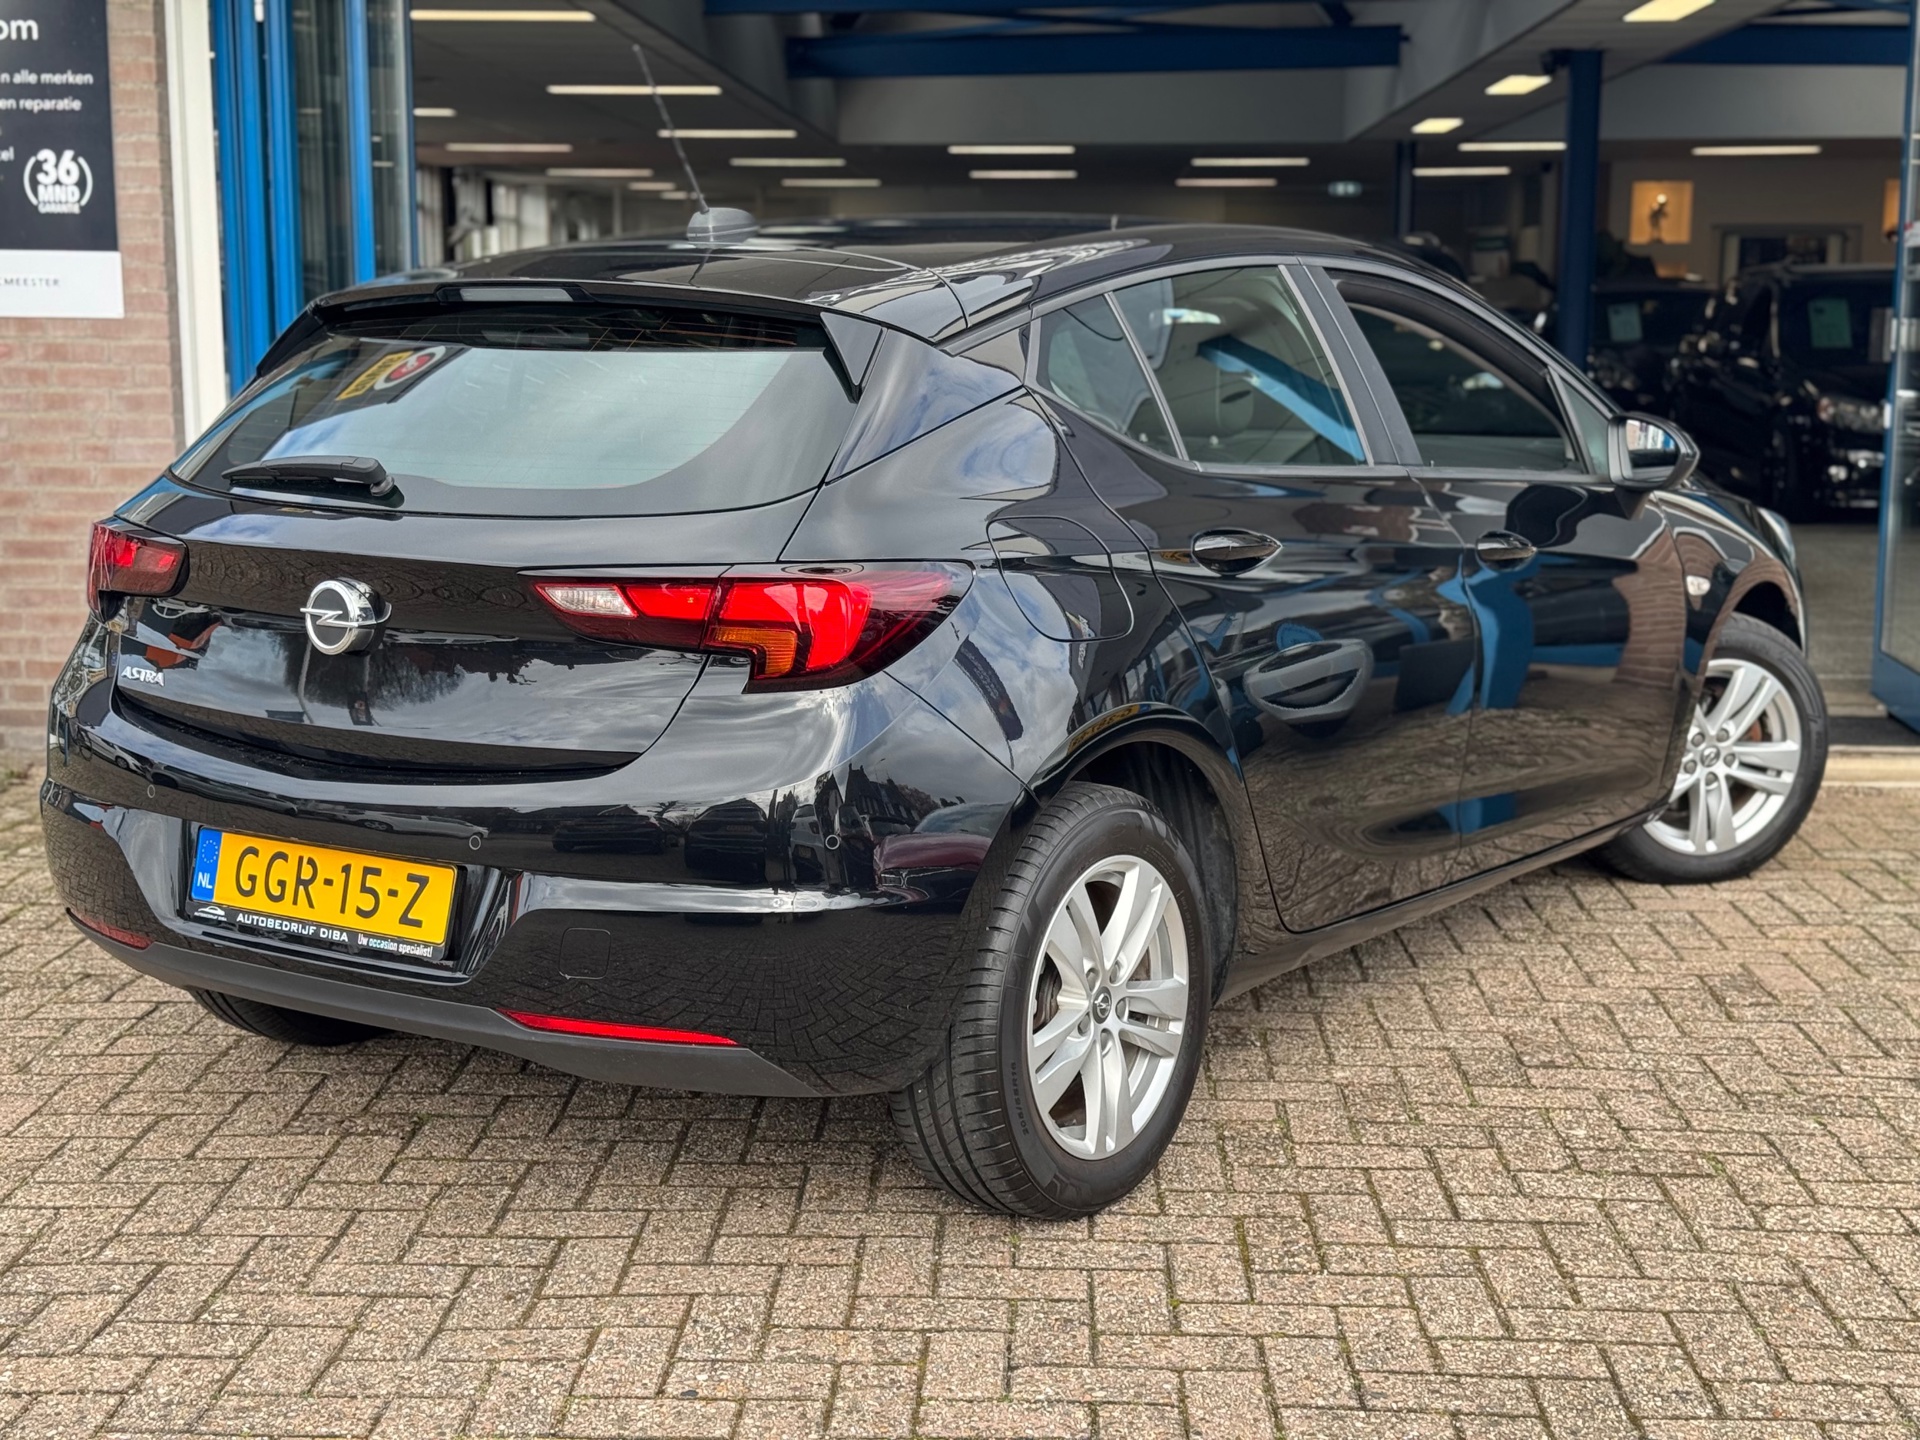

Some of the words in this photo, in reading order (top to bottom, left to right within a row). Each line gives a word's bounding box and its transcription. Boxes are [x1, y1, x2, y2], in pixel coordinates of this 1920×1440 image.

[13, 69, 38, 85] alle
[40, 69, 94, 85] merken
[19, 96, 82, 114] reparatie
[36, 148, 80, 185] 36
[37, 184, 80, 203] MND
[0, 277, 60, 287] MEESTER
[121, 665, 165, 687] ASTRA
[196, 871, 213, 889] NL
[234, 846, 430, 929] GGR-15-Z
[236, 912, 317, 936] AUTOBEDRIJF
[319, 928, 349, 943] DIBA
[357, 933, 369, 946] Uw
[368, 938, 398, 952] occasion
